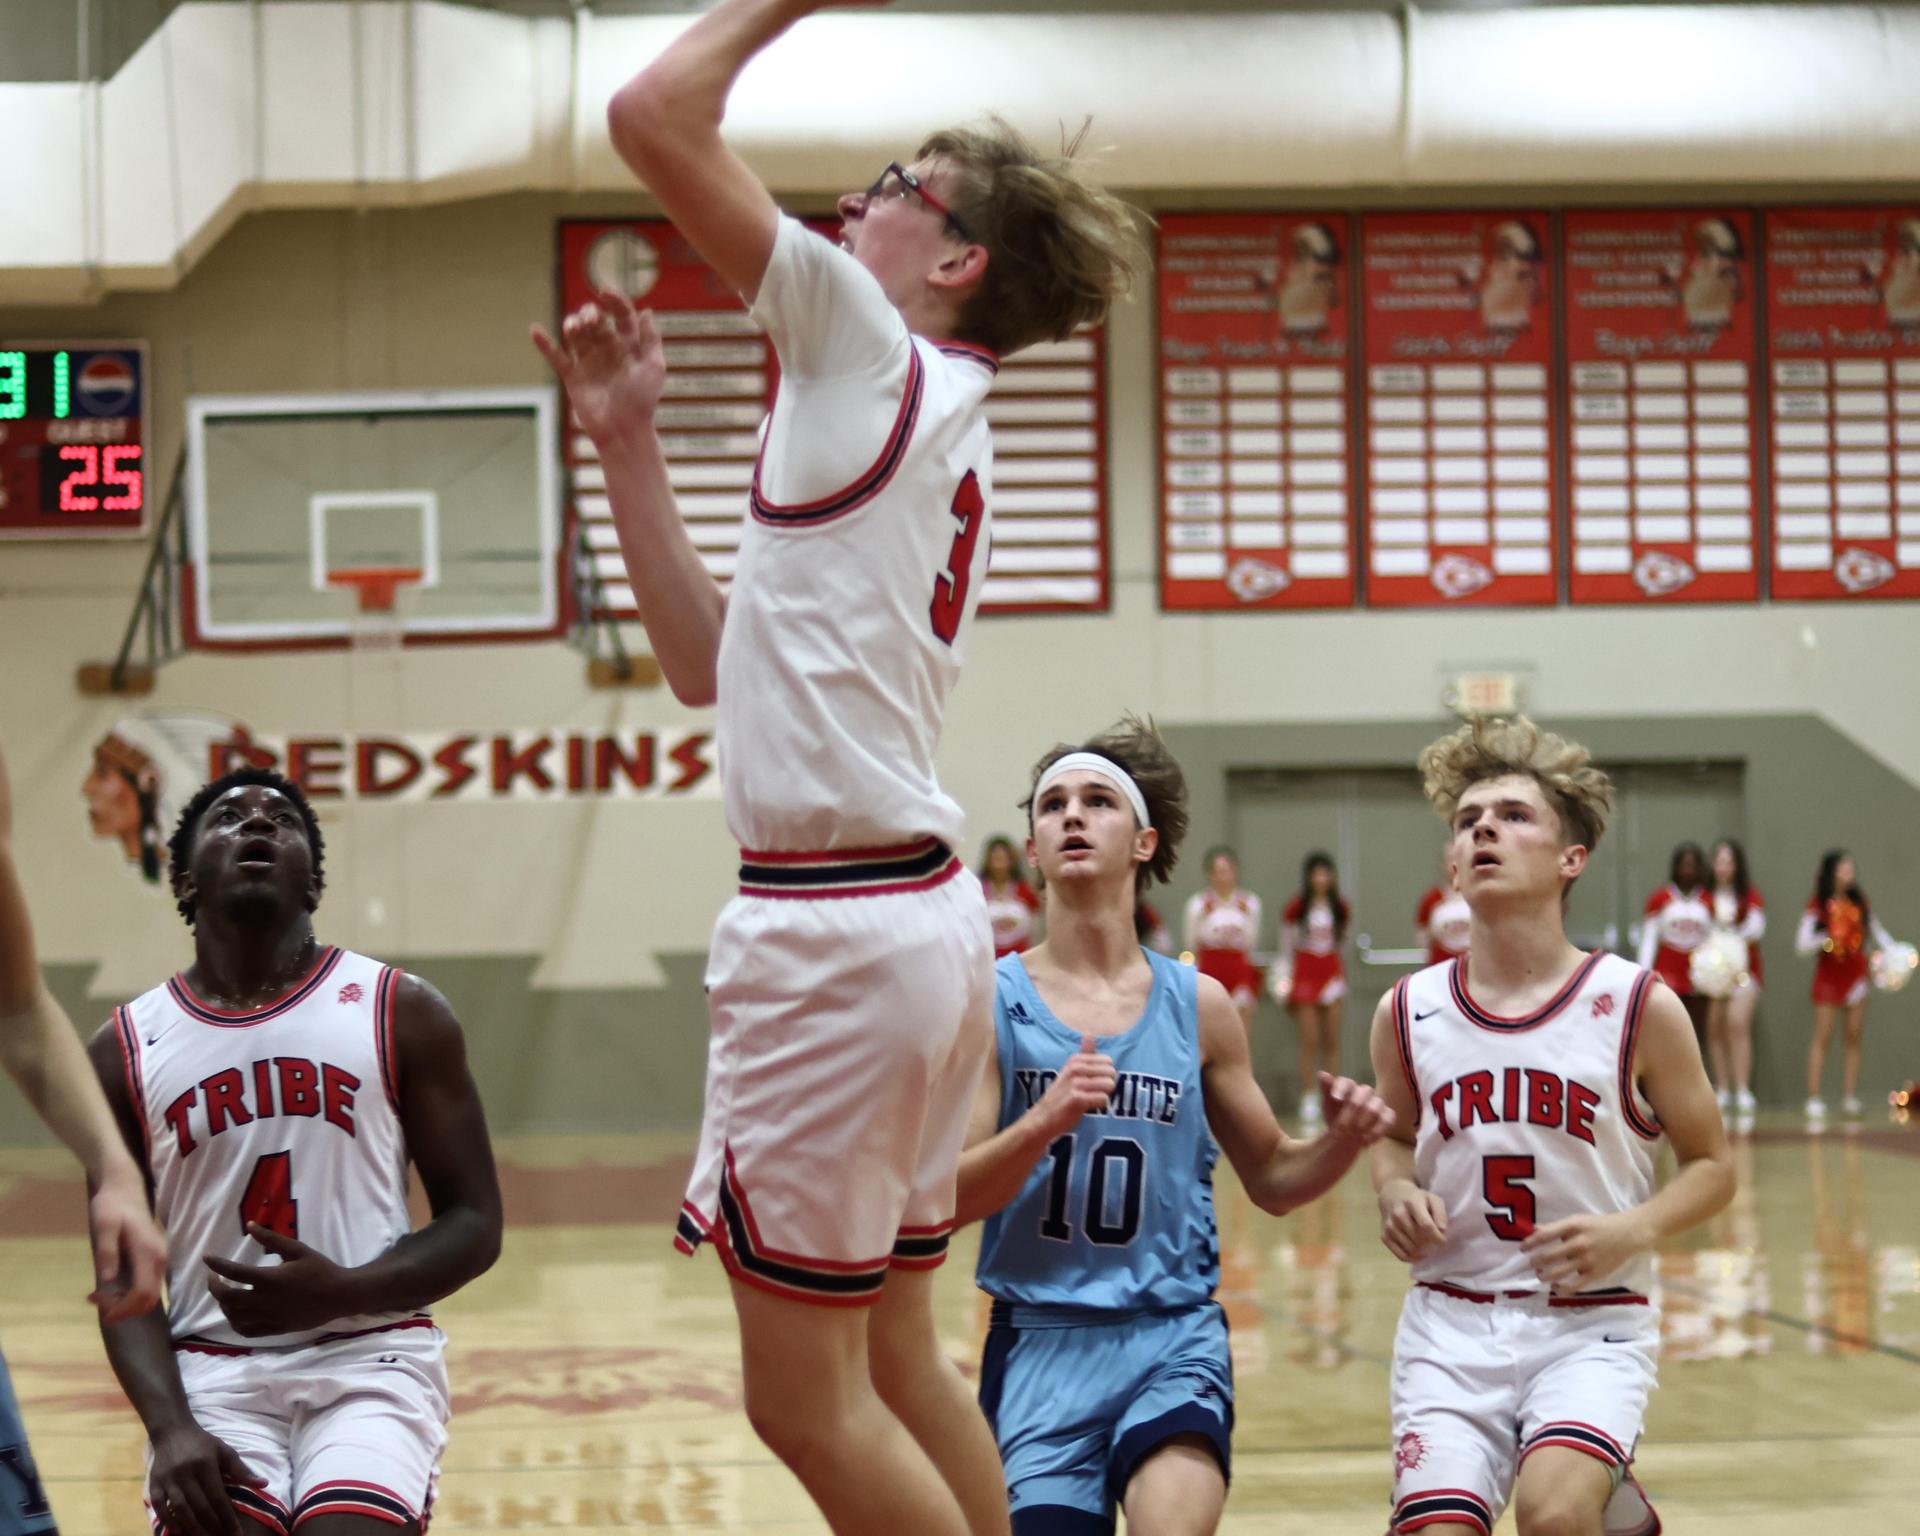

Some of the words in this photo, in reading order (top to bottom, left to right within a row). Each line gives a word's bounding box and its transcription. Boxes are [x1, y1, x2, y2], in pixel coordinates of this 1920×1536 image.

[59, 445, 142, 511] 25
[930, 467, 985, 647] 3
[164, 1056, 361, 1158] TRIBE
[1430, 1066, 1602, 1147] TRIBE
[239, 1149, 299, 1254] 4
[1039, 1132, 1149, 1248] 10
[1482, 1154, 1537, 1242] 5
